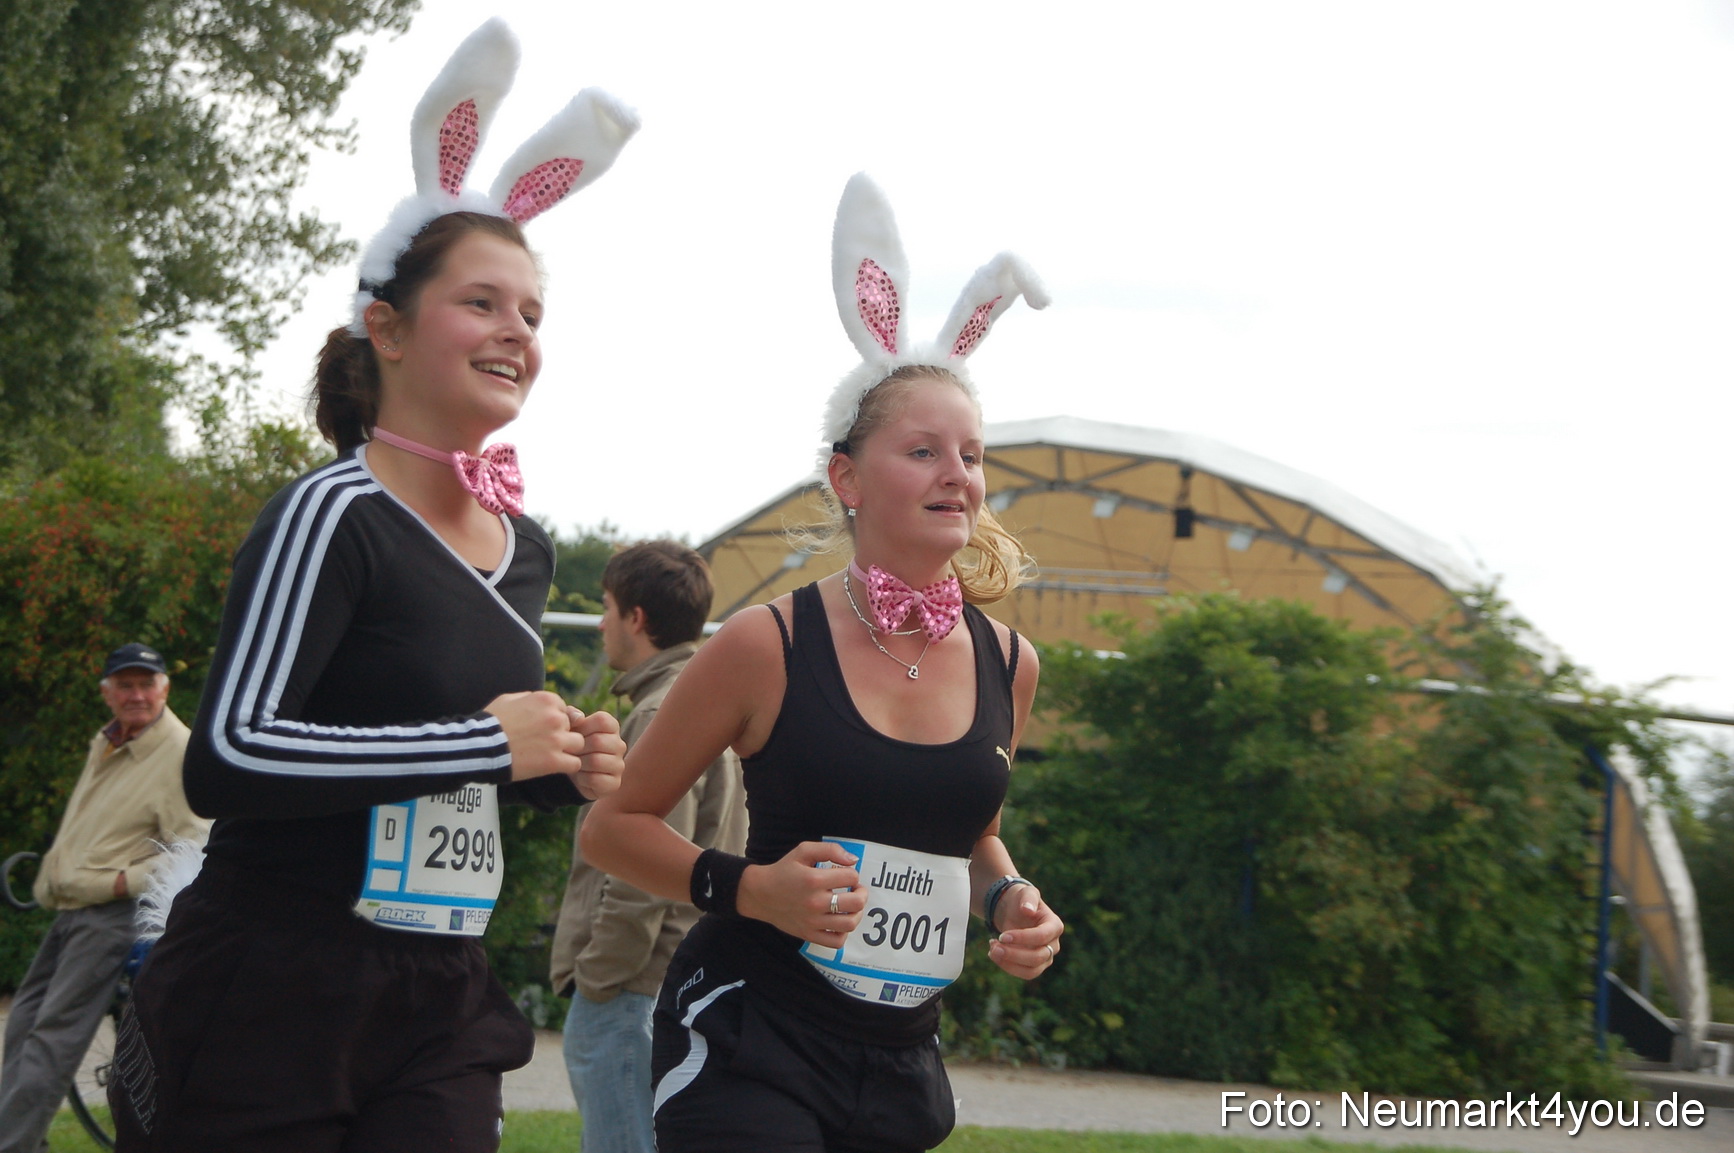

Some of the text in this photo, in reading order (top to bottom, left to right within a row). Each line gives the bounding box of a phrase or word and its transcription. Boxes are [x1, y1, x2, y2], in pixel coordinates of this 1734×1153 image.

[385, 818, 396, 840] D
[424, 825, 495, 873] 2999
[871, 861, 934, 896] Judith
[375, 907, 426, 922] BOCK
[863, 907, 950, 956] 3001
